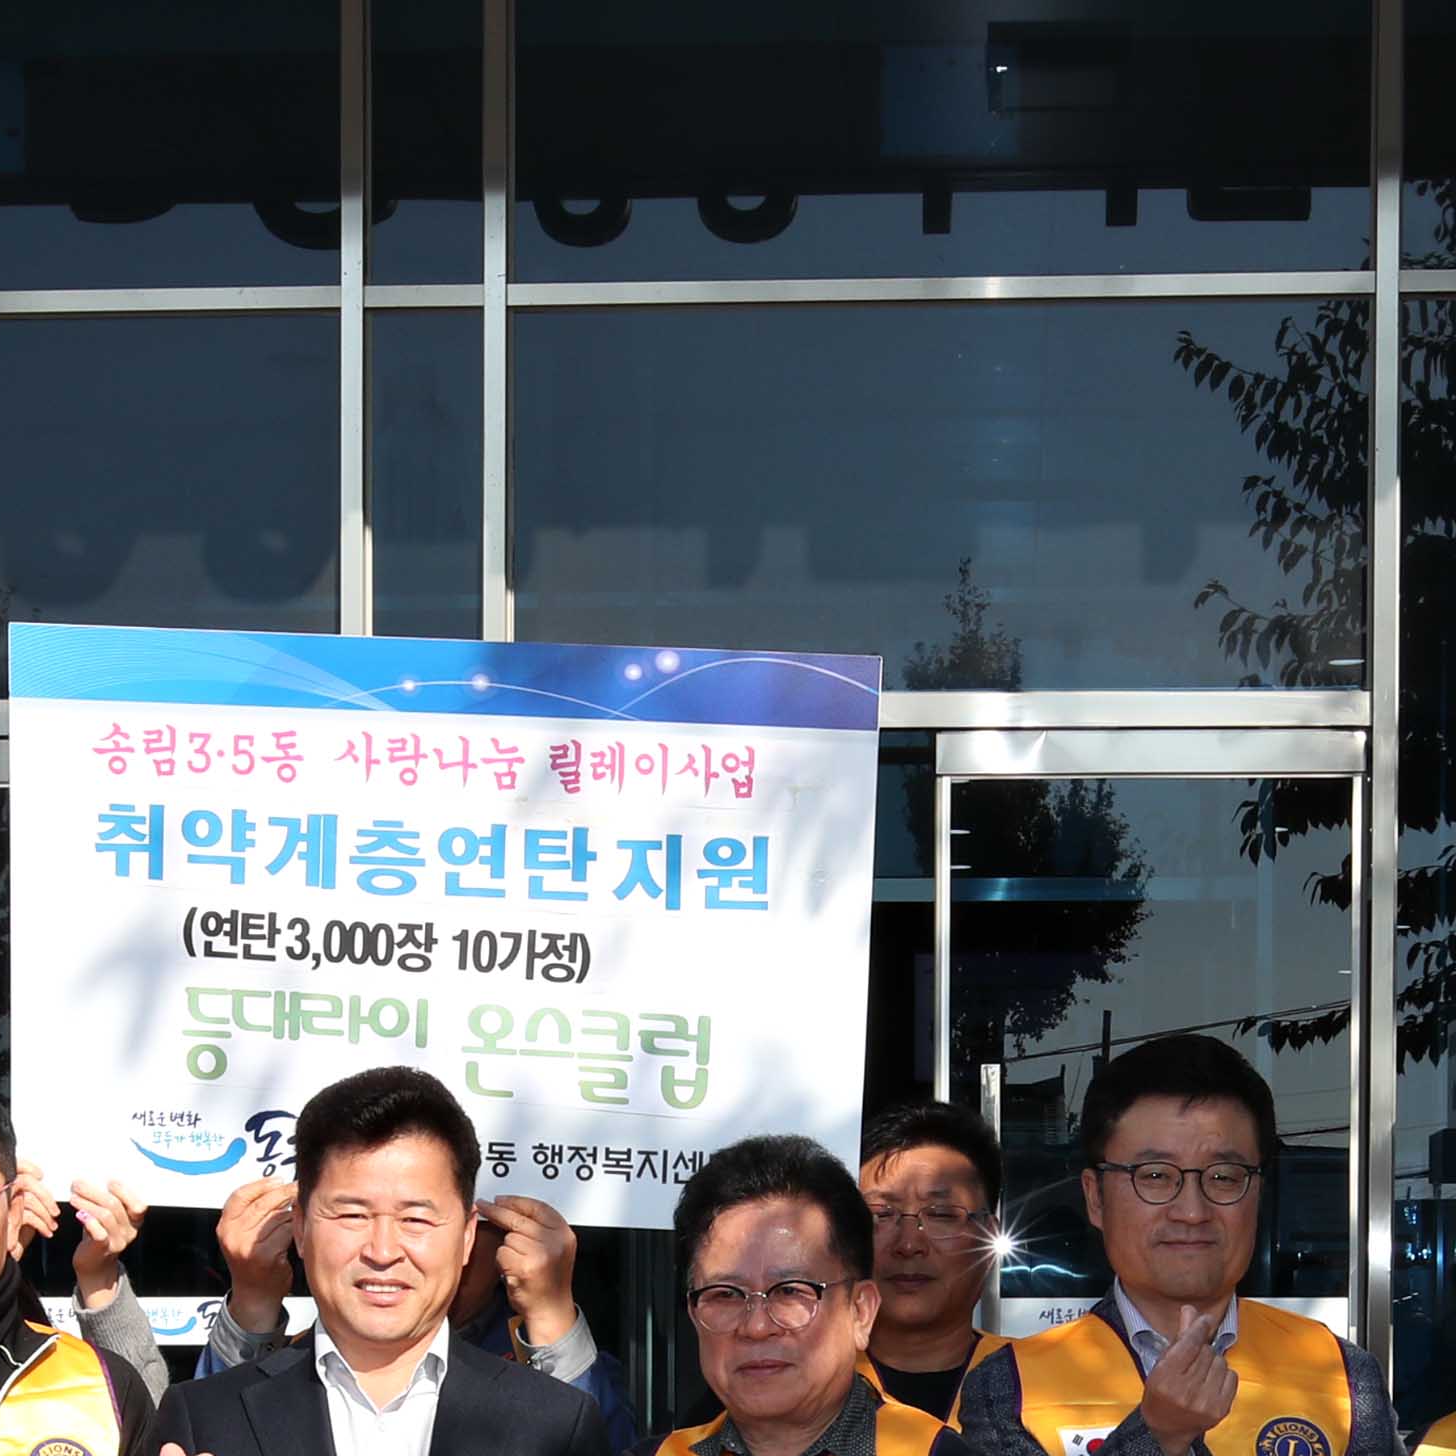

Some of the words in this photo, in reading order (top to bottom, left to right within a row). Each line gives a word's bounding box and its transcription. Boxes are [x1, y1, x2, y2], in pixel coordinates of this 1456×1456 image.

[333, 730, 526, 792] 사랑나눔
[548, 739, 756, 799] 릴레이사업
[183, 906, 439, 973] (연탄3,000장
[452, 929, 591, 984] 10가정)
[132, 1110, 166, 1127] 새로운
[170, 1111, 202, 1128] 변화
[245, 1110, 299, 1182] 동
[532, 1143, 704, 1184] 행정복지센
[1276, 1423, 1317, 1440] LIONS
